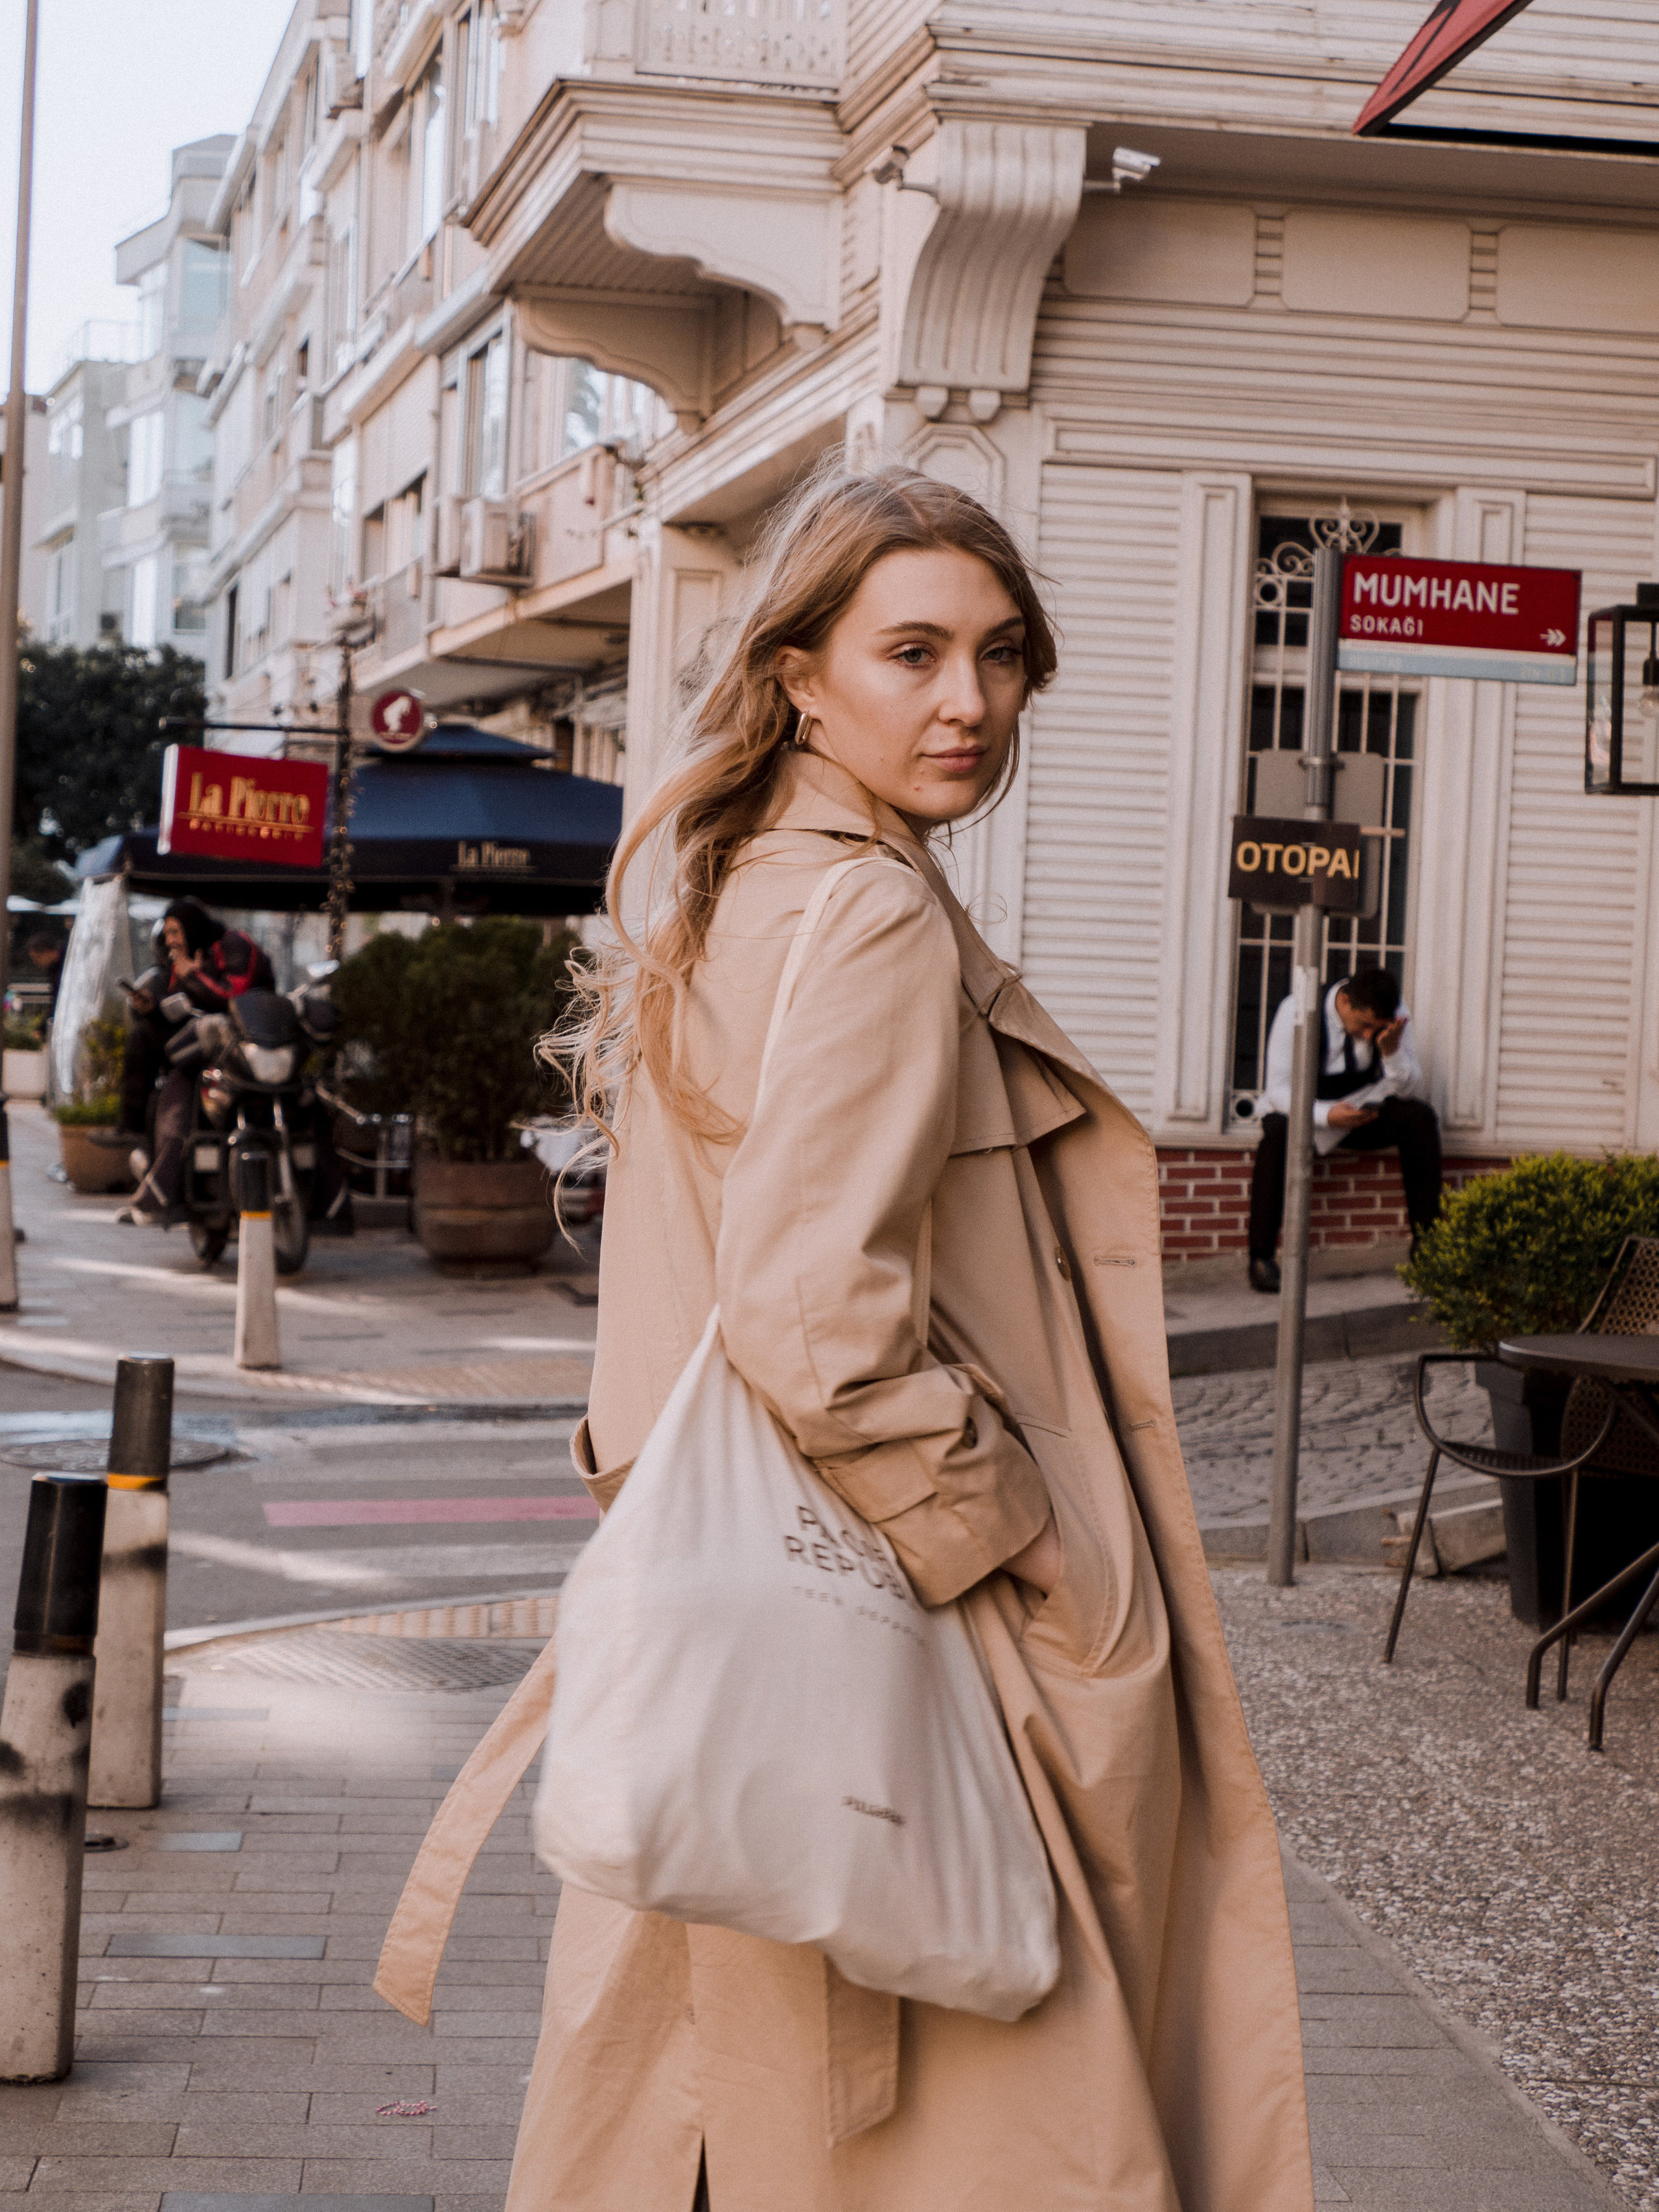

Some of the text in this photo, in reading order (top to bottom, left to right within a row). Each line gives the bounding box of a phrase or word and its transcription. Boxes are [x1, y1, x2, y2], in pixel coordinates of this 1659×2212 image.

[1353, 571, 1520, 615] MUMHANE
[1350, 614, 1424, 638] SOKAĞI
[189, 771, 224, 816] La
[458, 840, 479, 867] La
